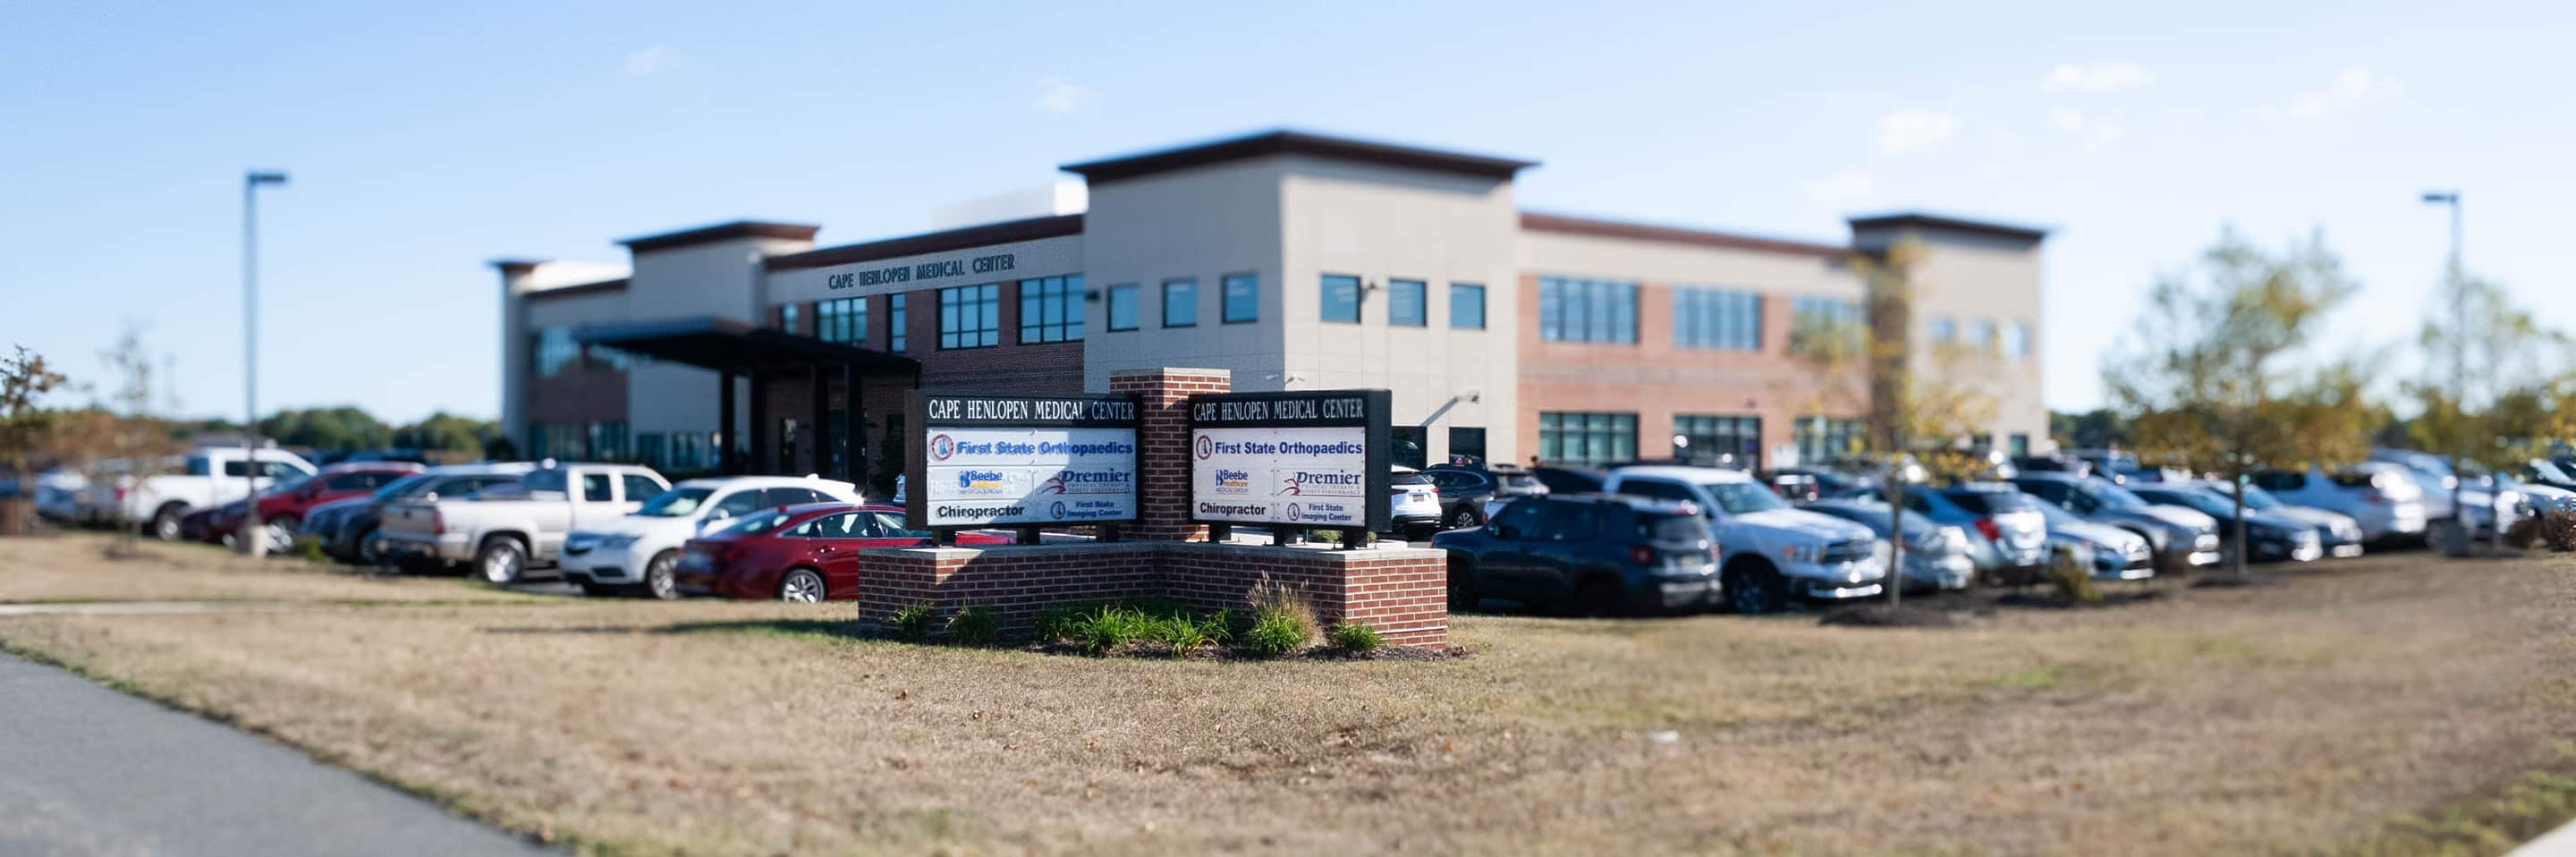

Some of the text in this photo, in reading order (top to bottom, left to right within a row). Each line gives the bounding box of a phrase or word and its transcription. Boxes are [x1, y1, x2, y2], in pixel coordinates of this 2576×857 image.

[828, 253, 1014, 289] CAPE HENLOPEN MEDICAL CENTER
[929, 399, 1135, 420] CAPE HENLOPEN MEDICAL CENTER
[1194, 398, 1364, 421] CAPE HENLOPEN MEDICAL CENTER
[957, 441, 1132, 456] First State Orthopaedics
[1215, 441, 1363, 457] First State Orthopaedics
[970, 470, 1003, 481] Beebe
[1059, 468, 1131, 483] Premier
[1224, 469, 1248, 480] Beebe
[1296, 469, 1361, 484] Premier
[937, 505, 1025, 519] Chiropractor
[1067, 510, 1097, 518] Imaging
[1199, 502, 1267, 516] Chiropractor
[1309, 503, 1343, 512] First State
[1301, 513, 1352, 522] Imaging Center
